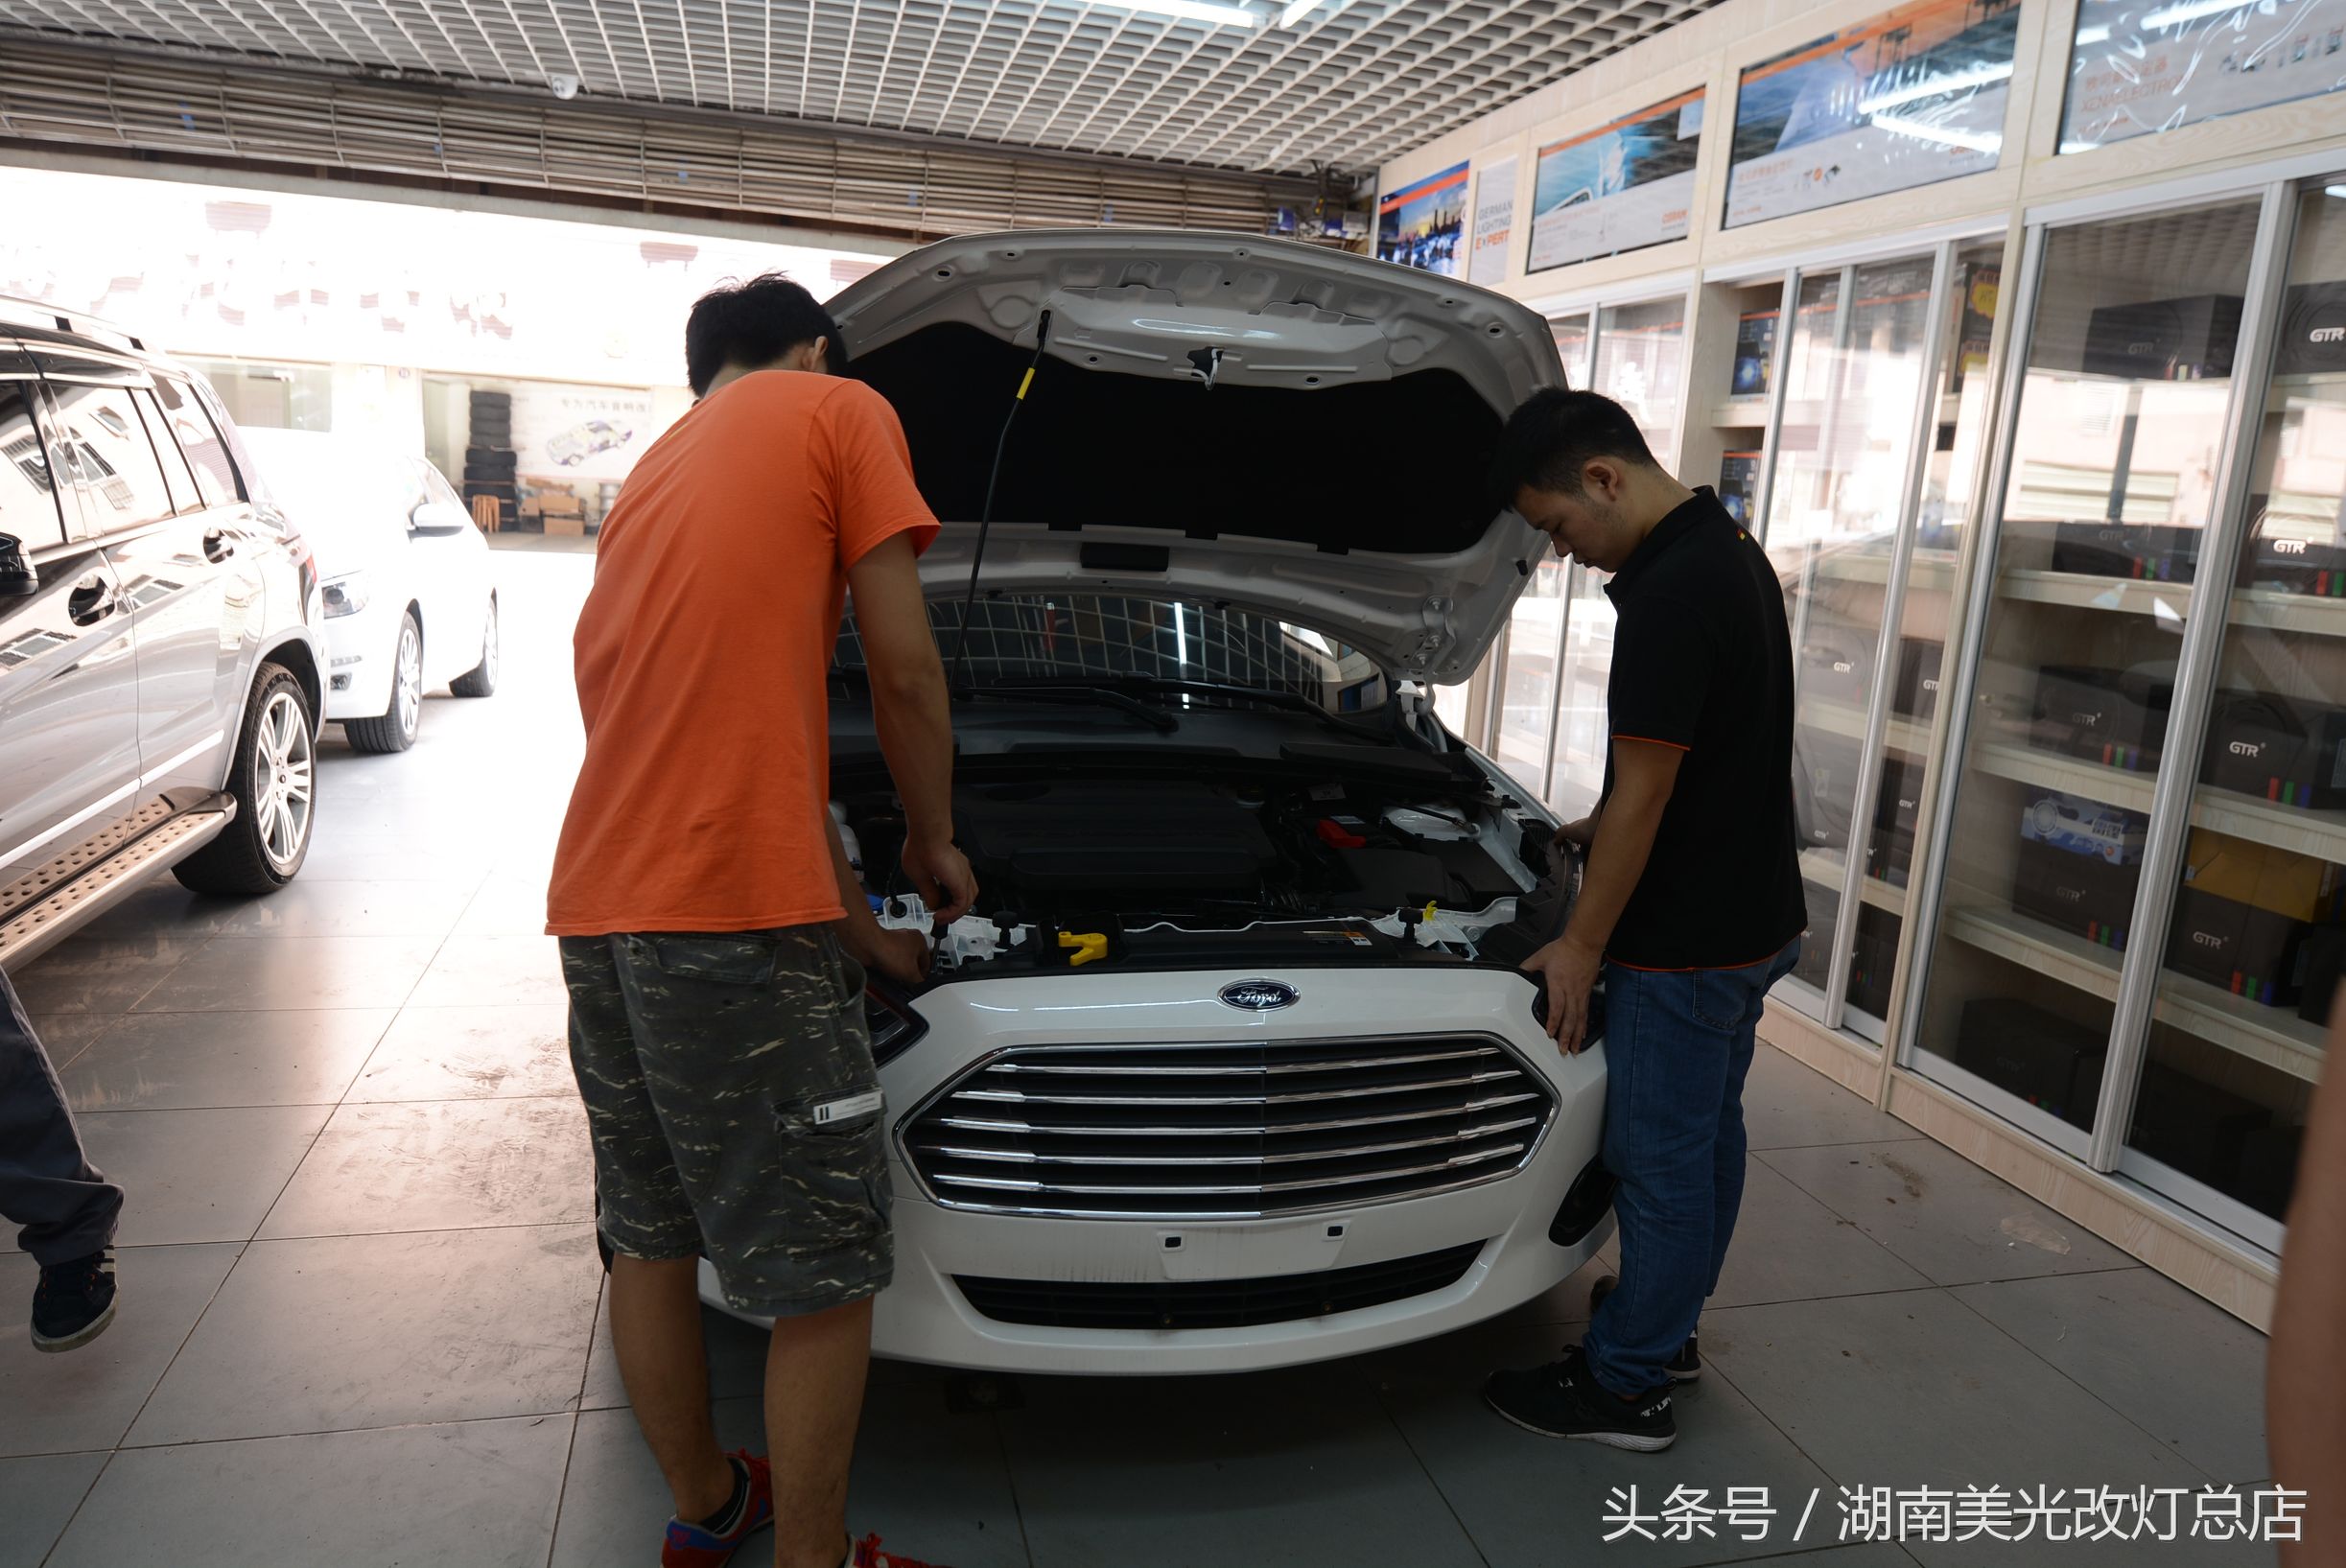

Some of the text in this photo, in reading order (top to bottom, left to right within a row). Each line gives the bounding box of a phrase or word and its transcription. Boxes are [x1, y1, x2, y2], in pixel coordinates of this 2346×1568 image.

[1478, 199, 1513, 221] GERMAN
[1476, 215, 1512, 235] LIGHTING
[2310, 327, 2346, 343] GTR
[2127, 341, 2155, 356] GTR
[2273, 539, 2307, 555] GTR
[1833, 662, 1852, 674] GTR
[2073, 713, 2098, 727] GTR
[2229, 740, 2261, 759] GTR
[1899, 799, 1913, 809] GTR
[2055, 885, 2081, 903] GTR
[2193, 931, 2223, 951] GTR
[1236, 986, 1281, 1008] Ford
